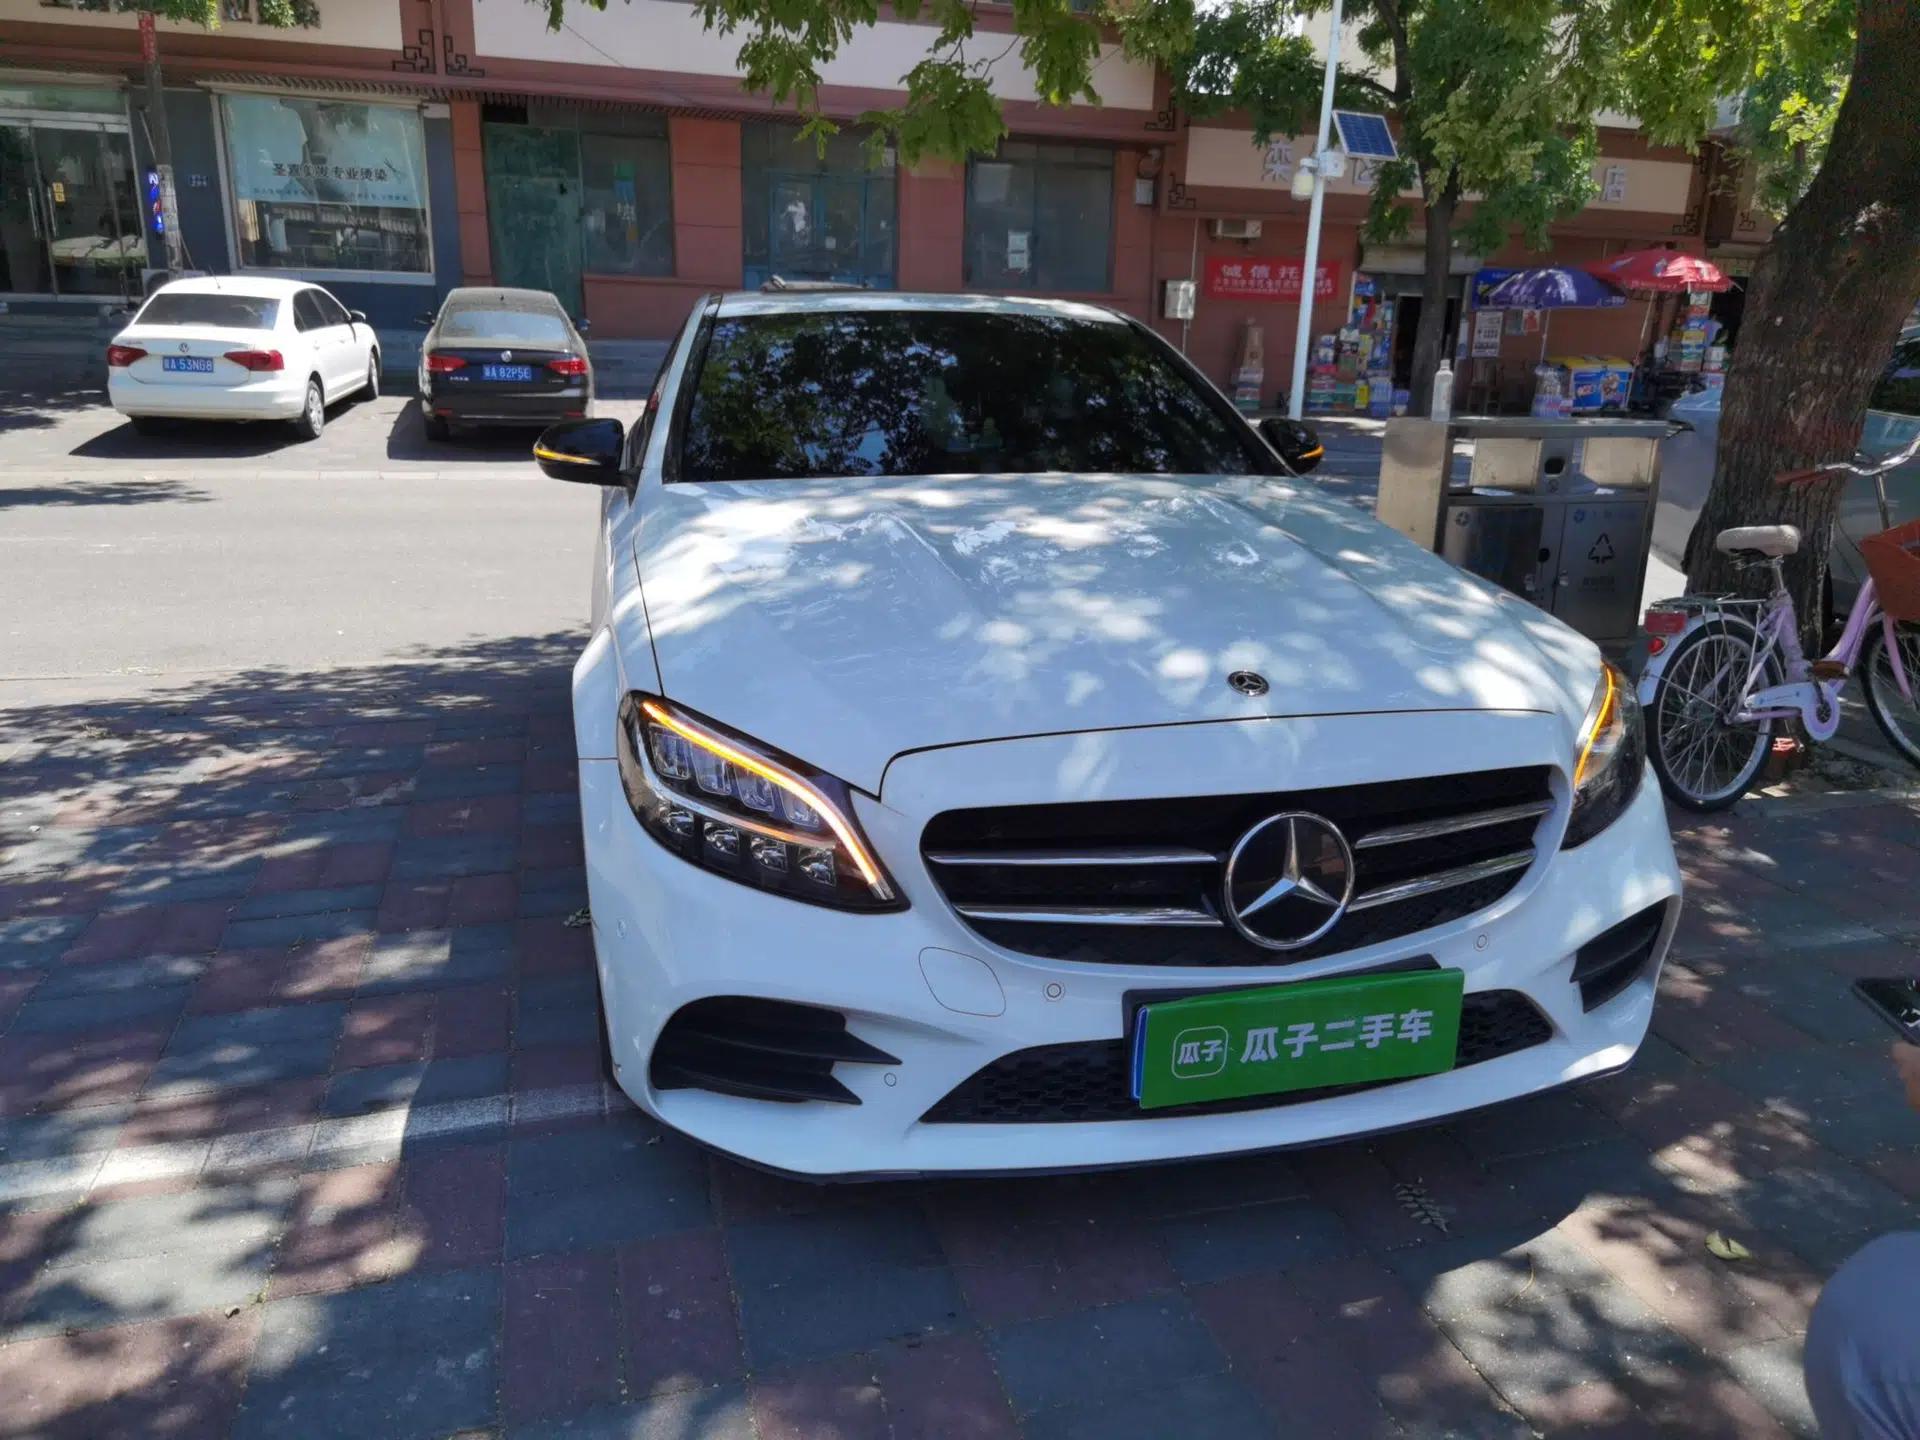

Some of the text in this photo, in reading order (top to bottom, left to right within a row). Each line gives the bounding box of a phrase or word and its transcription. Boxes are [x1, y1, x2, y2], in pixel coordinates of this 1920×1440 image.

[1177, 1039, 1223, 1065] 瓜子
[1240, 1008, 1434, 1064] 瓜子二手车
